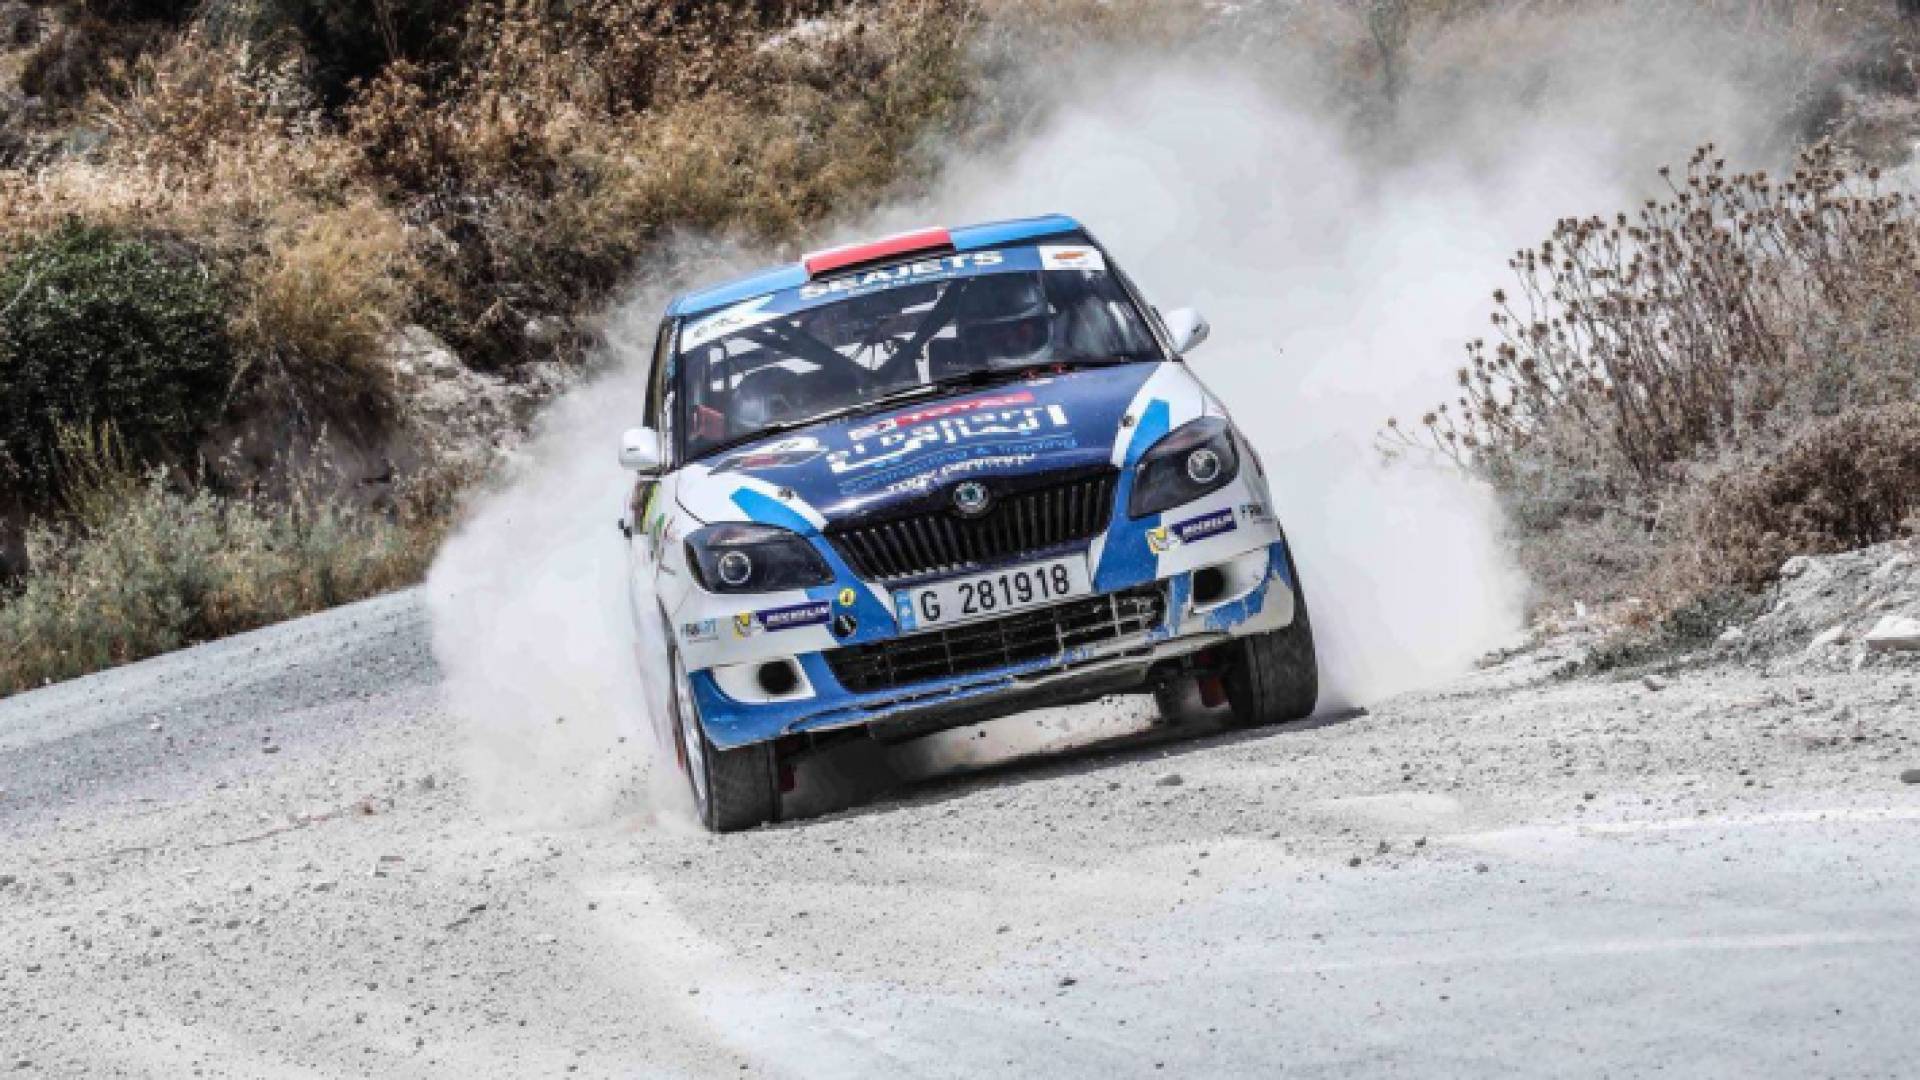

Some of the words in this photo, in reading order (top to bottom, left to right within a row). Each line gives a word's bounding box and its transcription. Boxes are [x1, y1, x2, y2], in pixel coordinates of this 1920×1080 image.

[800, 250, 1002, 297] SEAJETS
[920, 590, 941, 622] G
[958, 563, 1070, 614] 281918
